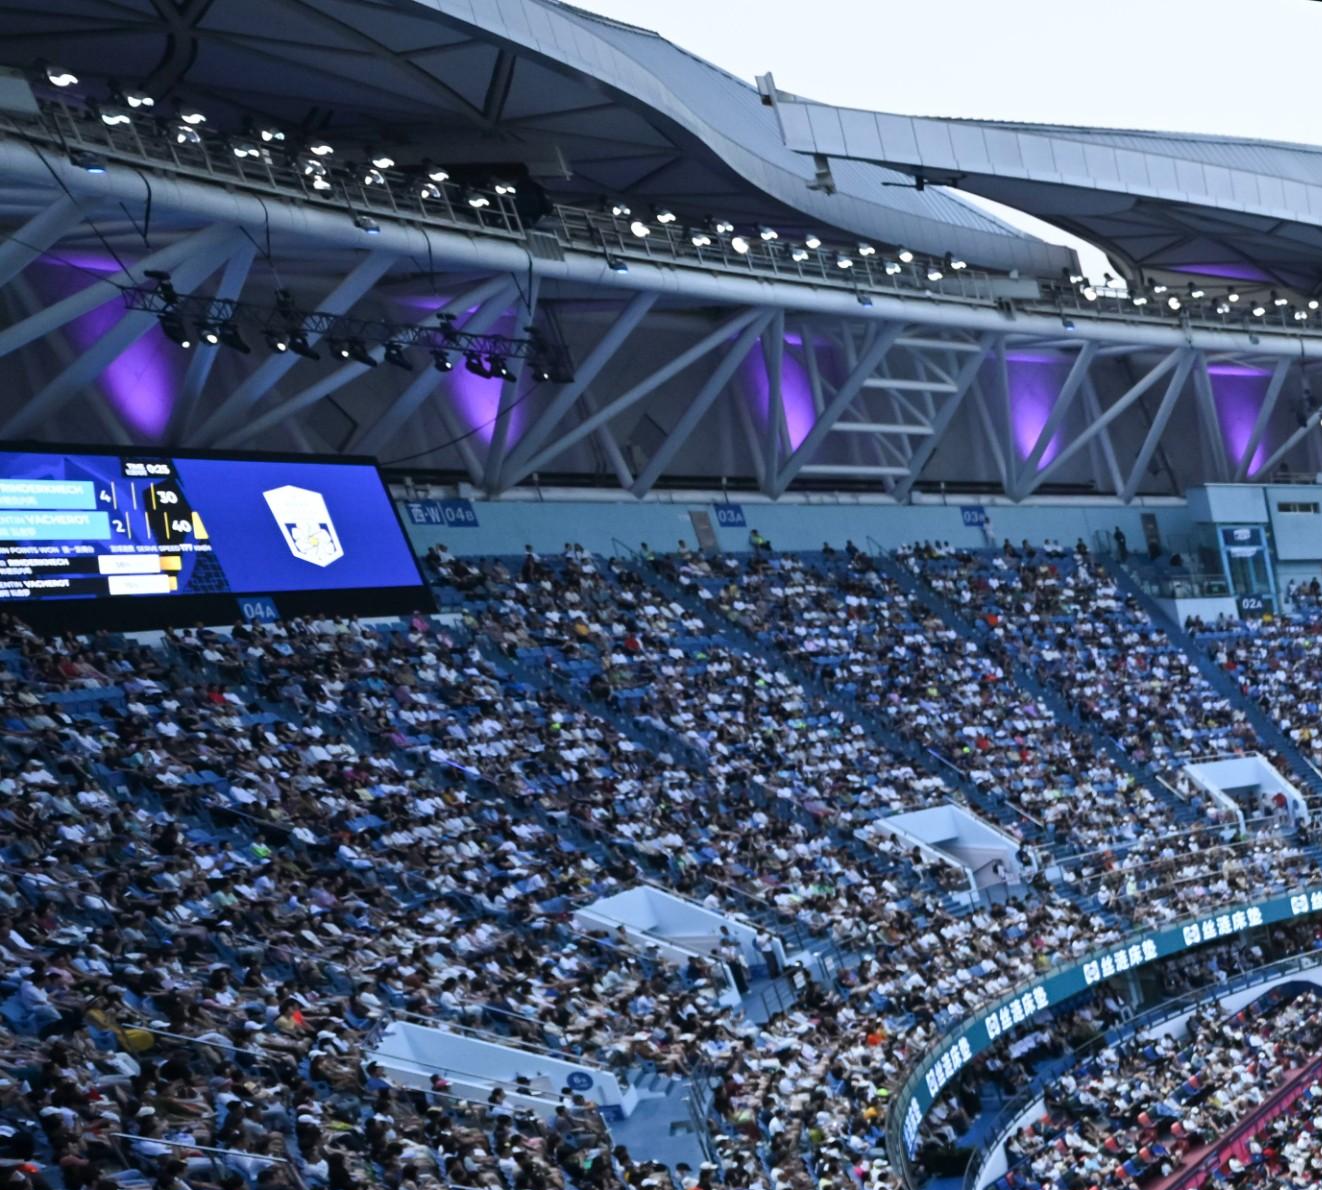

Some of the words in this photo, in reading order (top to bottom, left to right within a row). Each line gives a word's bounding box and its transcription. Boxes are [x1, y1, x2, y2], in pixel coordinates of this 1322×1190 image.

[100, 490, 111, 502] 4
[156, 491, 179, 504] 30
[446, 509, 474, 522] 04B
[718, 510, 743, 522] 03A
[112, 520, 125, 533] 2
[172, 520, 192, 532] 40
[1242, 598, 1263, 609] 02A
[243, 602, 276, 619] 04A
